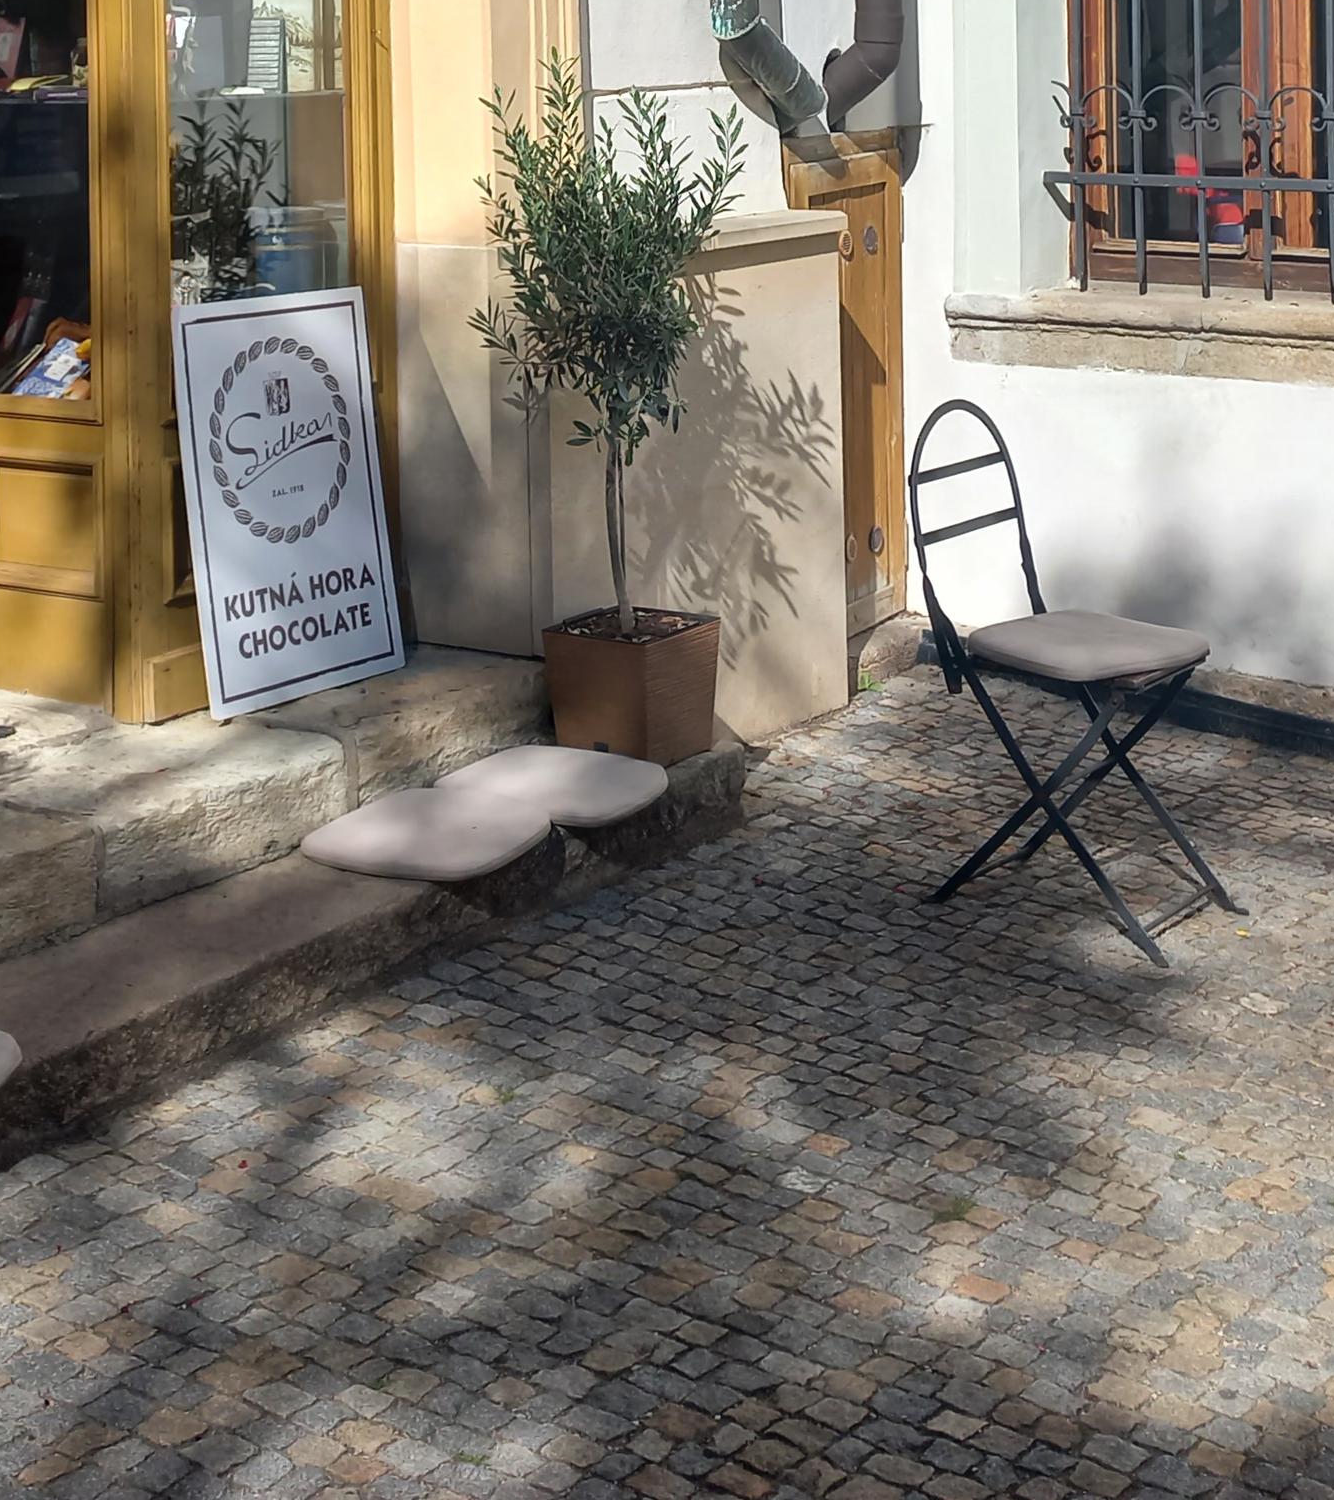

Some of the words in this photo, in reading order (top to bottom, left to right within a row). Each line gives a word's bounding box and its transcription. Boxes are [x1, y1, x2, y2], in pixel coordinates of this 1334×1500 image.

[224, 572, 304, 622] KUTNÁ
[309, 563, 375, 601] HORA
[238, 603, 372, 659] CHOCOLATE
